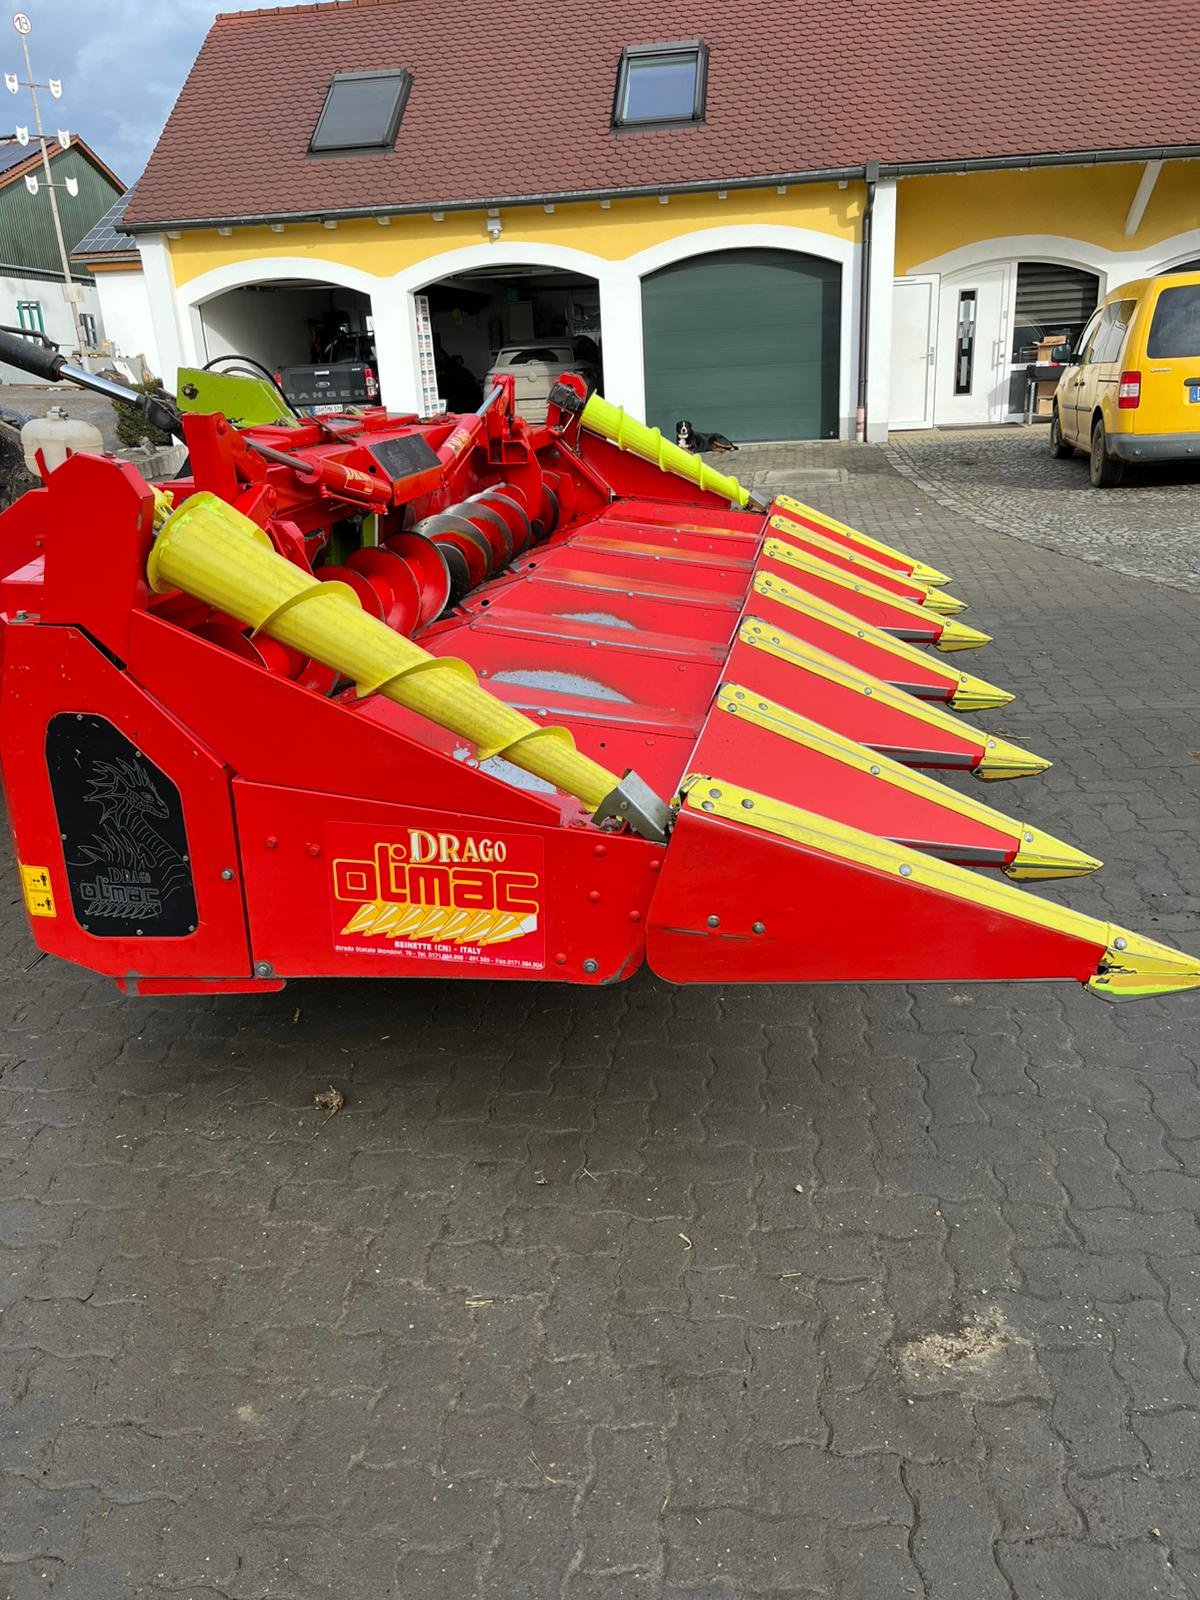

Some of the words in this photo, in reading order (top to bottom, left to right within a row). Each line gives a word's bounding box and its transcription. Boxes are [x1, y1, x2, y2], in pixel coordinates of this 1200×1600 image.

[15, 17, 29, 32] 18
[285, 389, 364, 400] RANGER
[408, 828, 507, 863] DRAGO
[332, 843, 539, 915] olimac
[355, 946, 376, 954] Statale
[394, 941, 432, 950] BEINETTE
[434, 943, 451, 952] (CN)
[460, 945, 481, 955] ITALY
